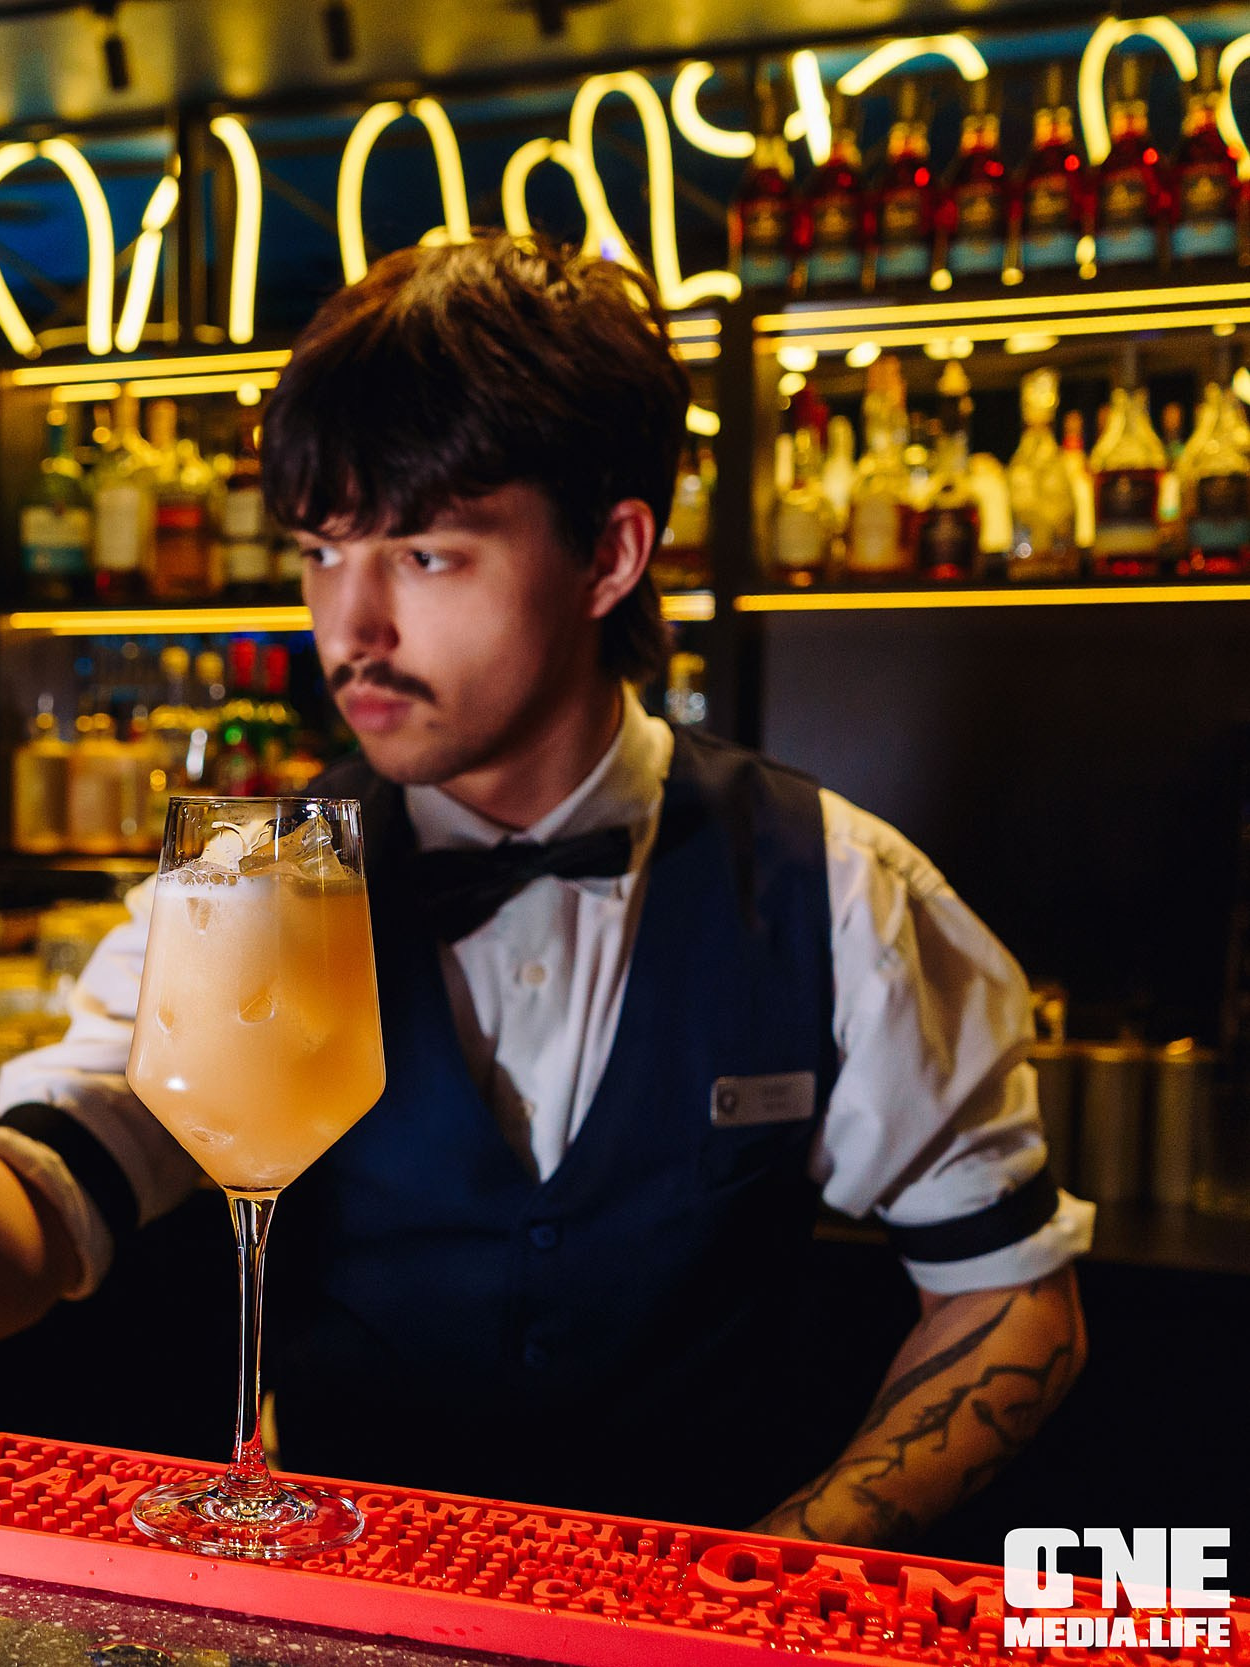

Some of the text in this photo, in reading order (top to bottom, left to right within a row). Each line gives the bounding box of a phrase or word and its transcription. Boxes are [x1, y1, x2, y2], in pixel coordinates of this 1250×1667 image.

[355, 1493, 617, 1543] CAMPARI
[461, 1531, 652, 1568] CAMPARI
[302, 1559, 458, 1592] CAMPARI
